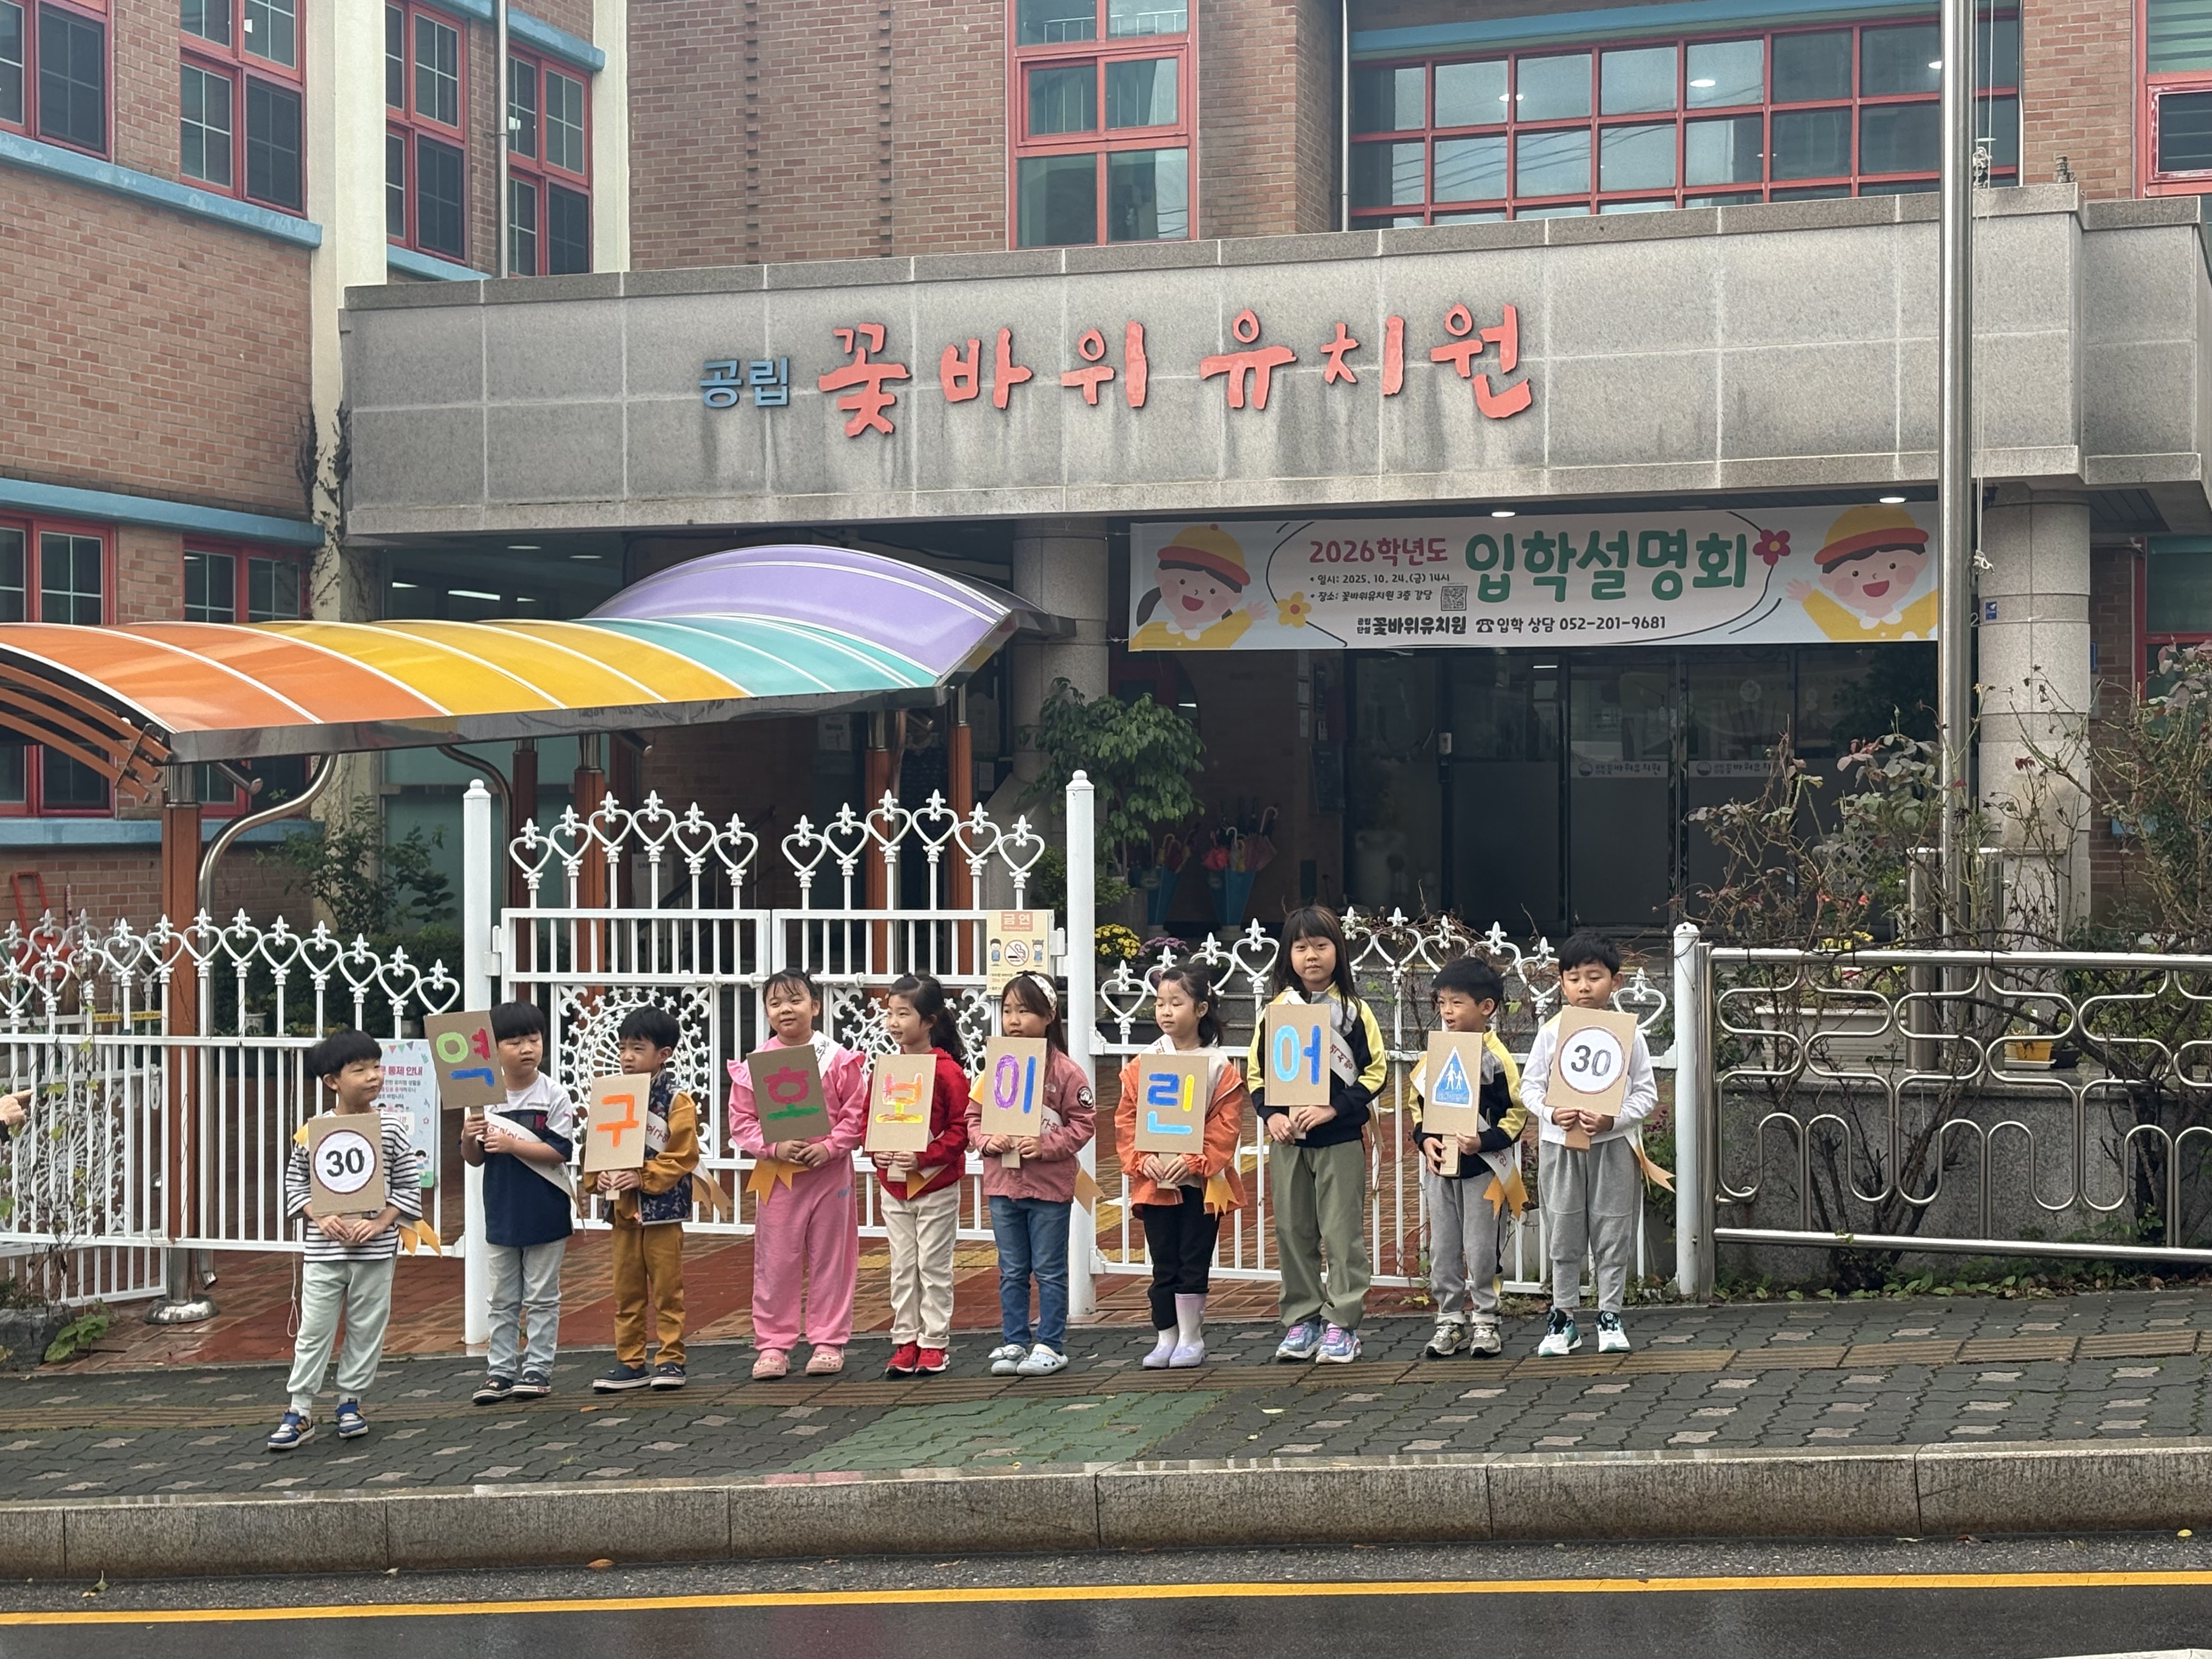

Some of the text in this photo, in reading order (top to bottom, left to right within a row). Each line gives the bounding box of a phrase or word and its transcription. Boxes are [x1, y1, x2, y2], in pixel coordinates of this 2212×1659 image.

[699, 357, 789, 408] 공립
[1309, 538, 1448, 566] 2026학년도
[1429, 573, 1450, 582] 14시
[1465, 528, 1747, 603] 입학설명회
[1341, 590, 1395, 602] 꽃바위유치원
[1396, 590, 1411, 601] 3층
[1414, 590, 1432, 600] 강당
[1372, 616, 1666, 635] 꽃바위유치원 입학 상담 052-201-9681
[436, 1026, 494, 1087] 역
[1273, 1024, 1321, 1086] 어
[1570, 1045, 1611, 1077] 30
[763, 1066, 821, 1121] 호
[875, 1073, 923, 1124] 보
[994, 1054, 1036, 1114] 이
[1147, 1072, 1195, 1136] 린
[596, 1092, 640, 1148] 구
[326, 1147, 365, 1178] 30
